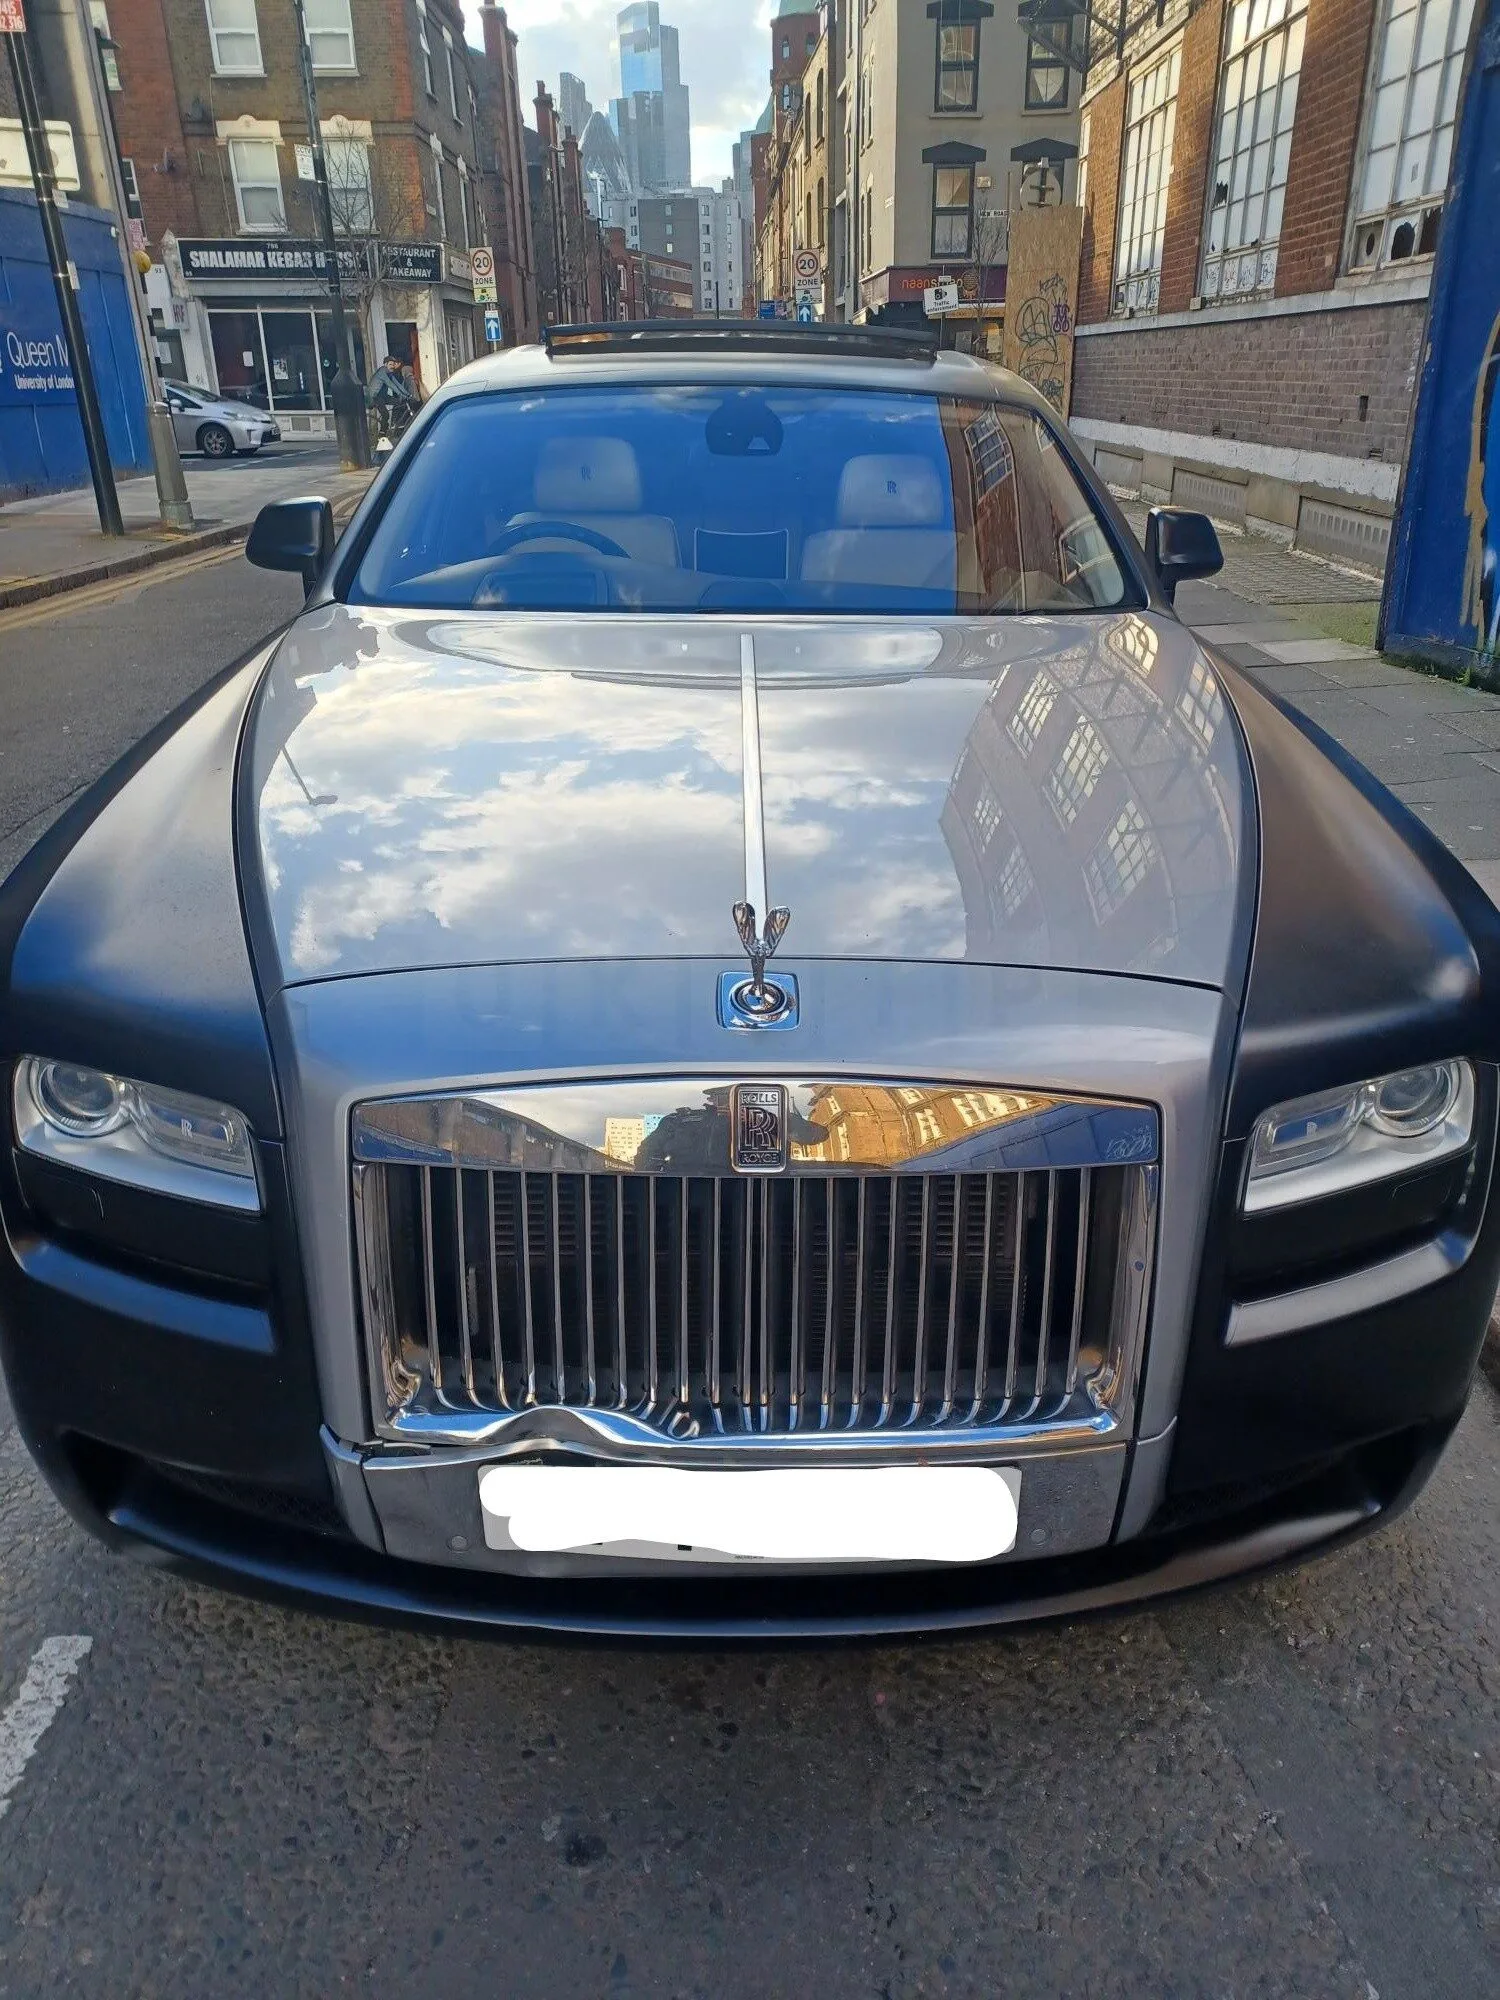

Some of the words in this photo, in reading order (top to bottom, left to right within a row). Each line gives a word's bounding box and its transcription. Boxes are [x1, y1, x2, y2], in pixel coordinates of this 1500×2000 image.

[190, 251, 266, 268] SHALAMAR
[266, 251, 313, 268] KEBAB
[406, 258, 413, 267] &
[475, 257, 489, 268] 20
[799, 258, 816, 270] 20
[389, 267, 432, 278] TAKEAWAY
[797, 278, 819, 286] ZONE
[927, 303, 957, 312] enforcement
[7, 331, 57, 369] Queen
[14, 374, 48, 393] University
[47, 374, 55, 389] of
[742, 1093, 777, 1104] ROLLS
[742, 1153, 779, 1163] ROYCE
